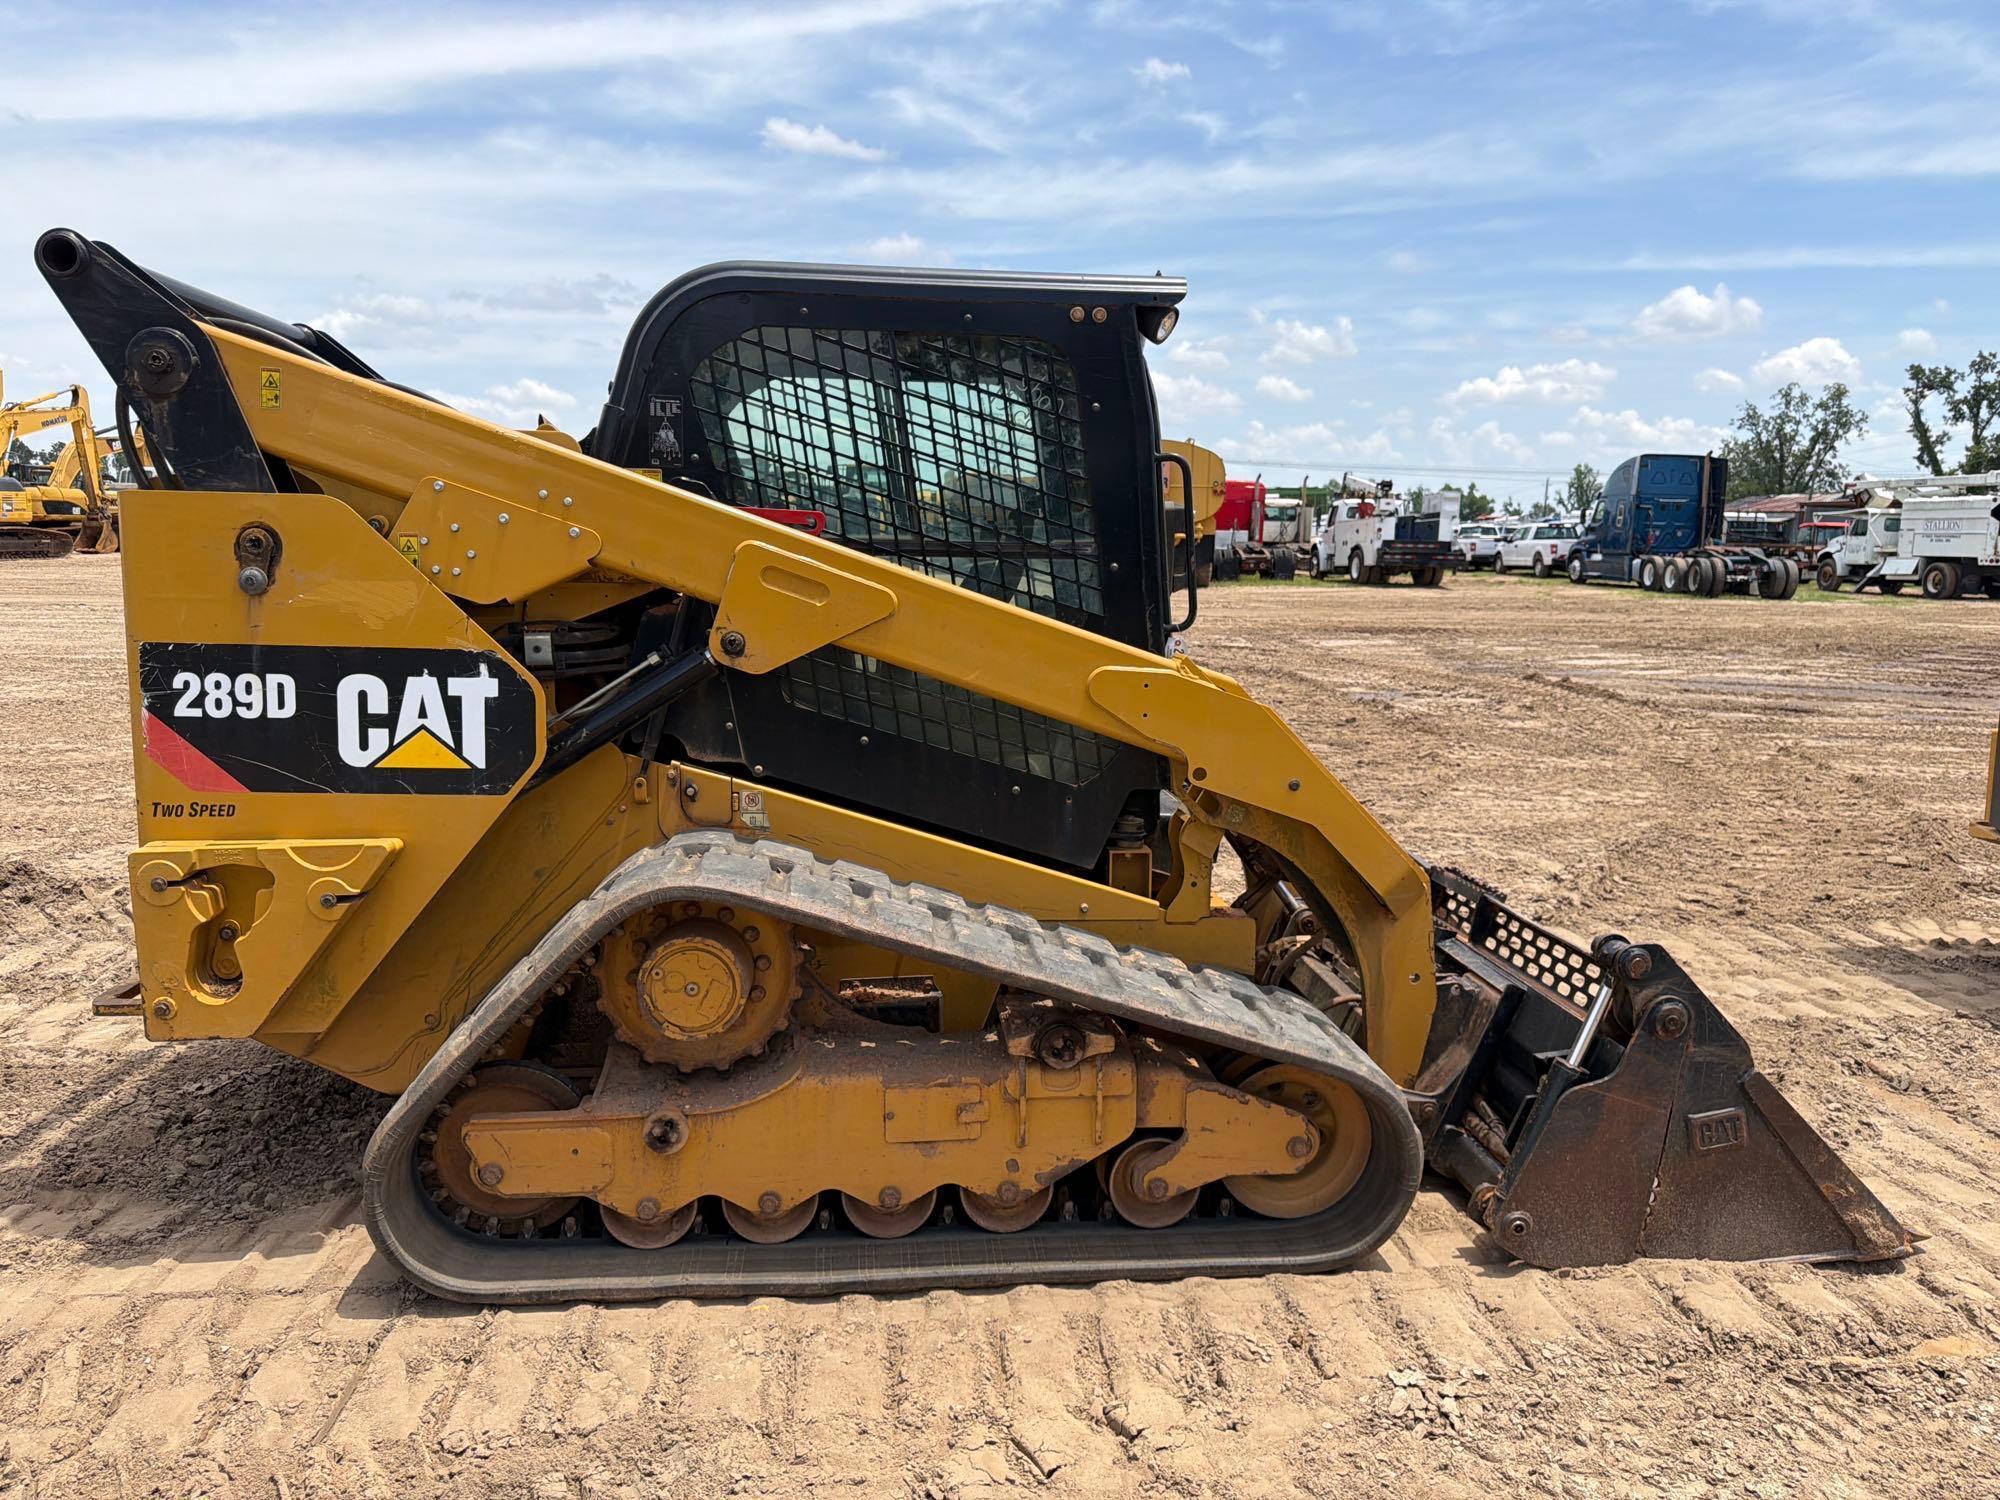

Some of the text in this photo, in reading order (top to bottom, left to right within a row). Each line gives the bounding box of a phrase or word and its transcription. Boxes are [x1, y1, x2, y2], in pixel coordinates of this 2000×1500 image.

[42, 415, 67, 427] KOMATSU
[1924, 520, 1960, 531] STALLION
[172, 672, 499, 769] 289D CAT
[152, 801, 236, 818] TWO SPEED
[1700, 1116, 1740, 1147] CAT
